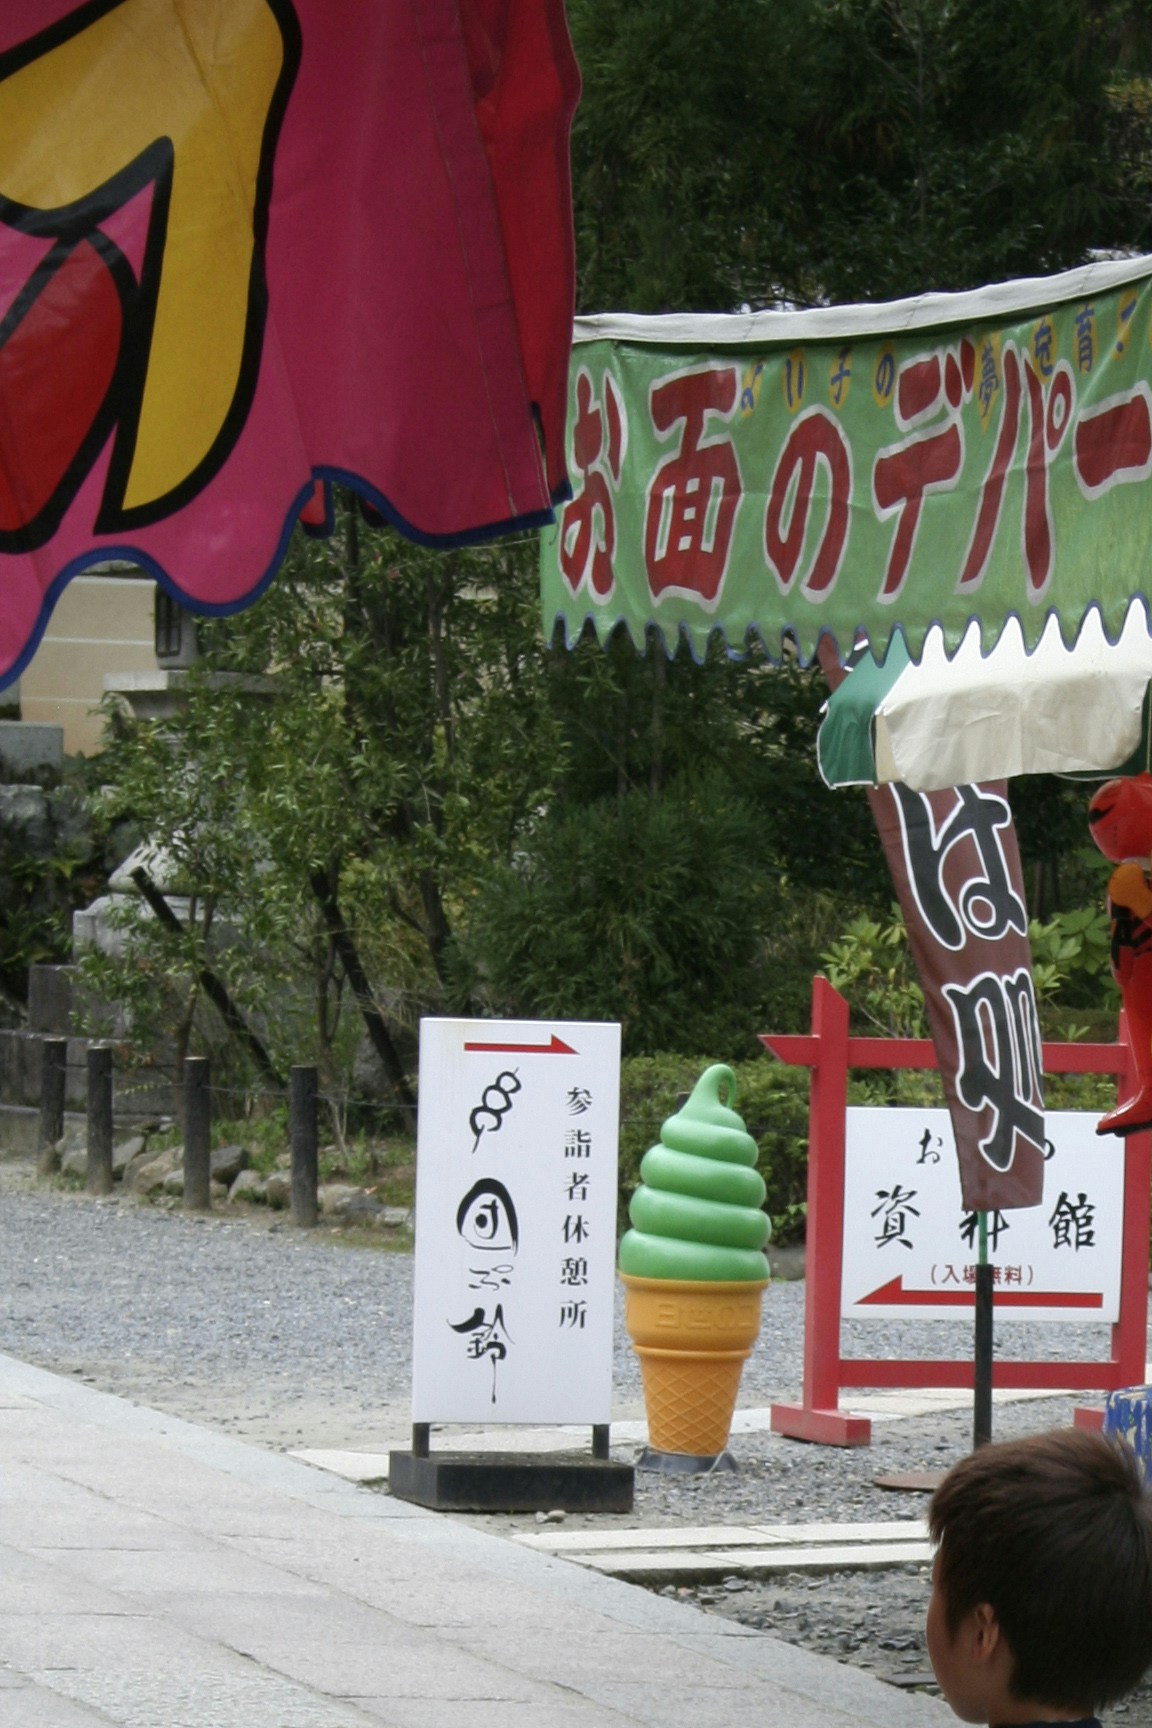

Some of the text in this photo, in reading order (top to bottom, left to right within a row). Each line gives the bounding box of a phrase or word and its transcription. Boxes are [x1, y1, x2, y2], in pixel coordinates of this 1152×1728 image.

[558, 1085, 594, 1330] 参詣者休憩所
[870, 1184, 1097, 1253] 資料館
